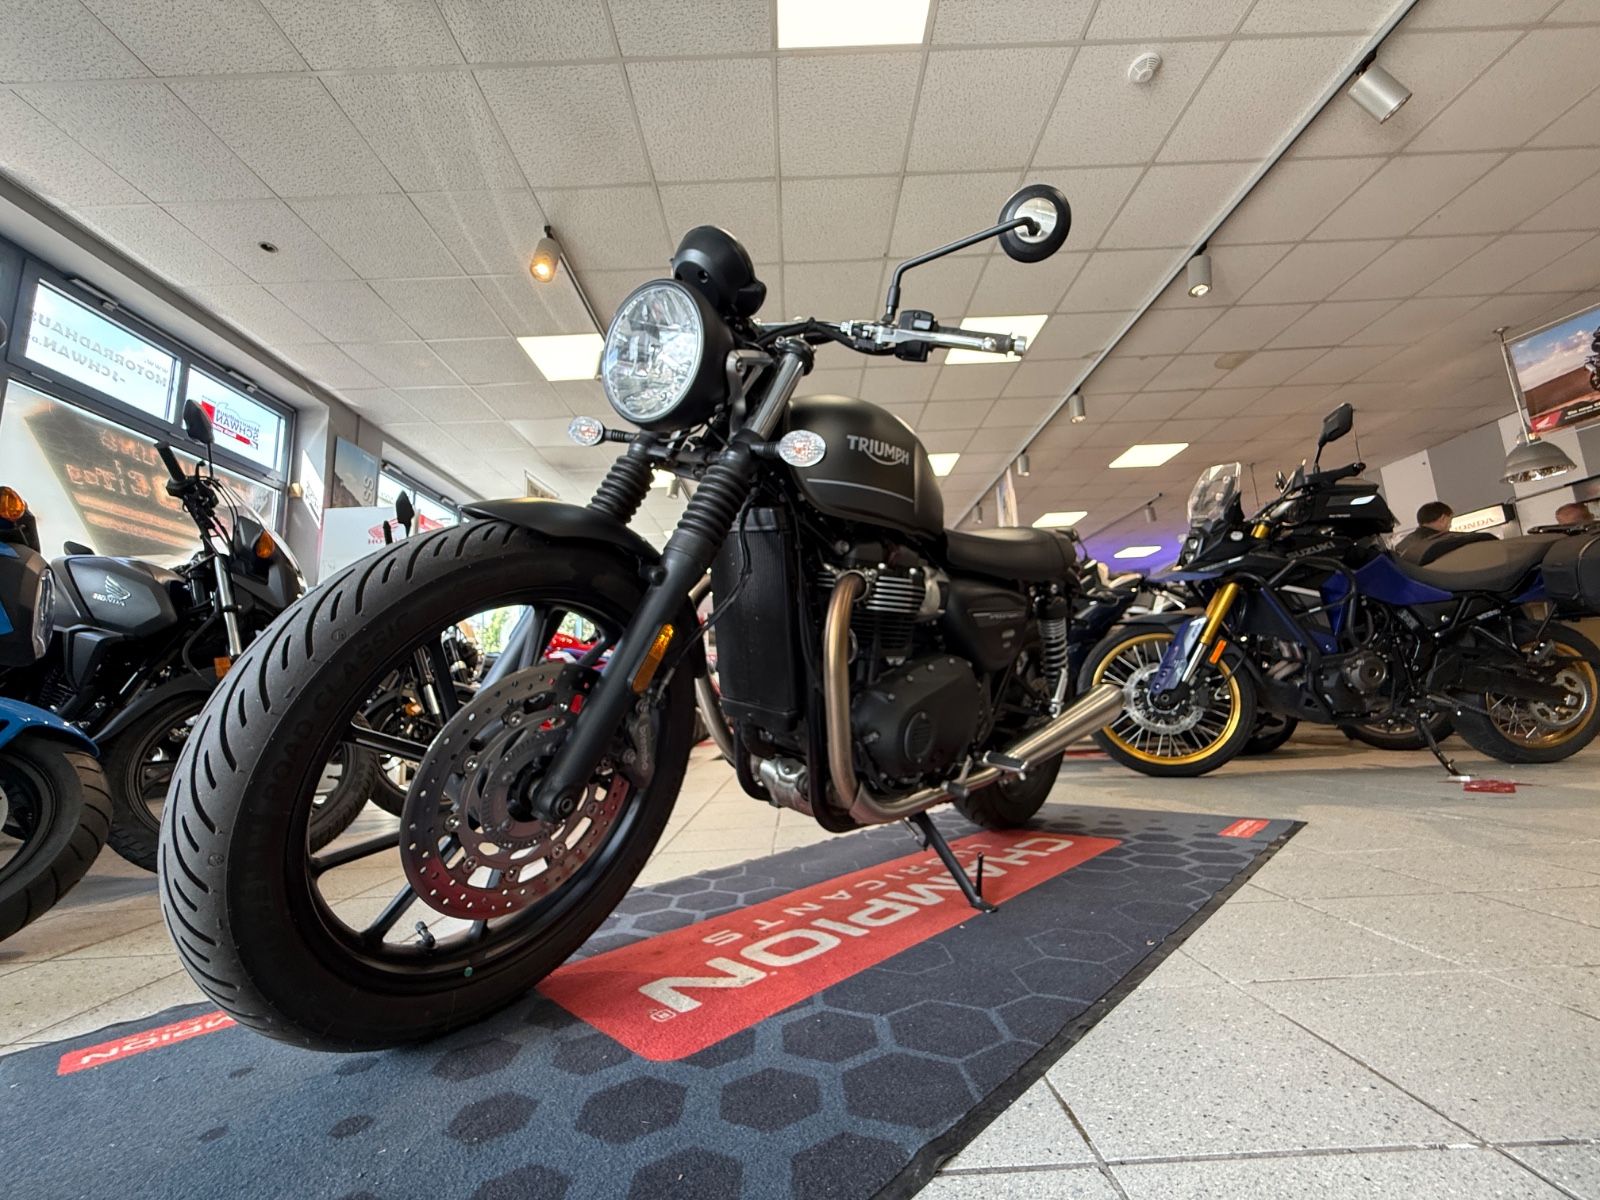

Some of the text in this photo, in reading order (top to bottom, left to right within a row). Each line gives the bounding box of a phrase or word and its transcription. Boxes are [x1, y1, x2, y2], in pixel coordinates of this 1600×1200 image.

[846, 434, 910, 466] TRIUMPH
[1285, 540, 1336, 559] SUZUKI
[637, 836, 1077, 1013] CHAMPION
